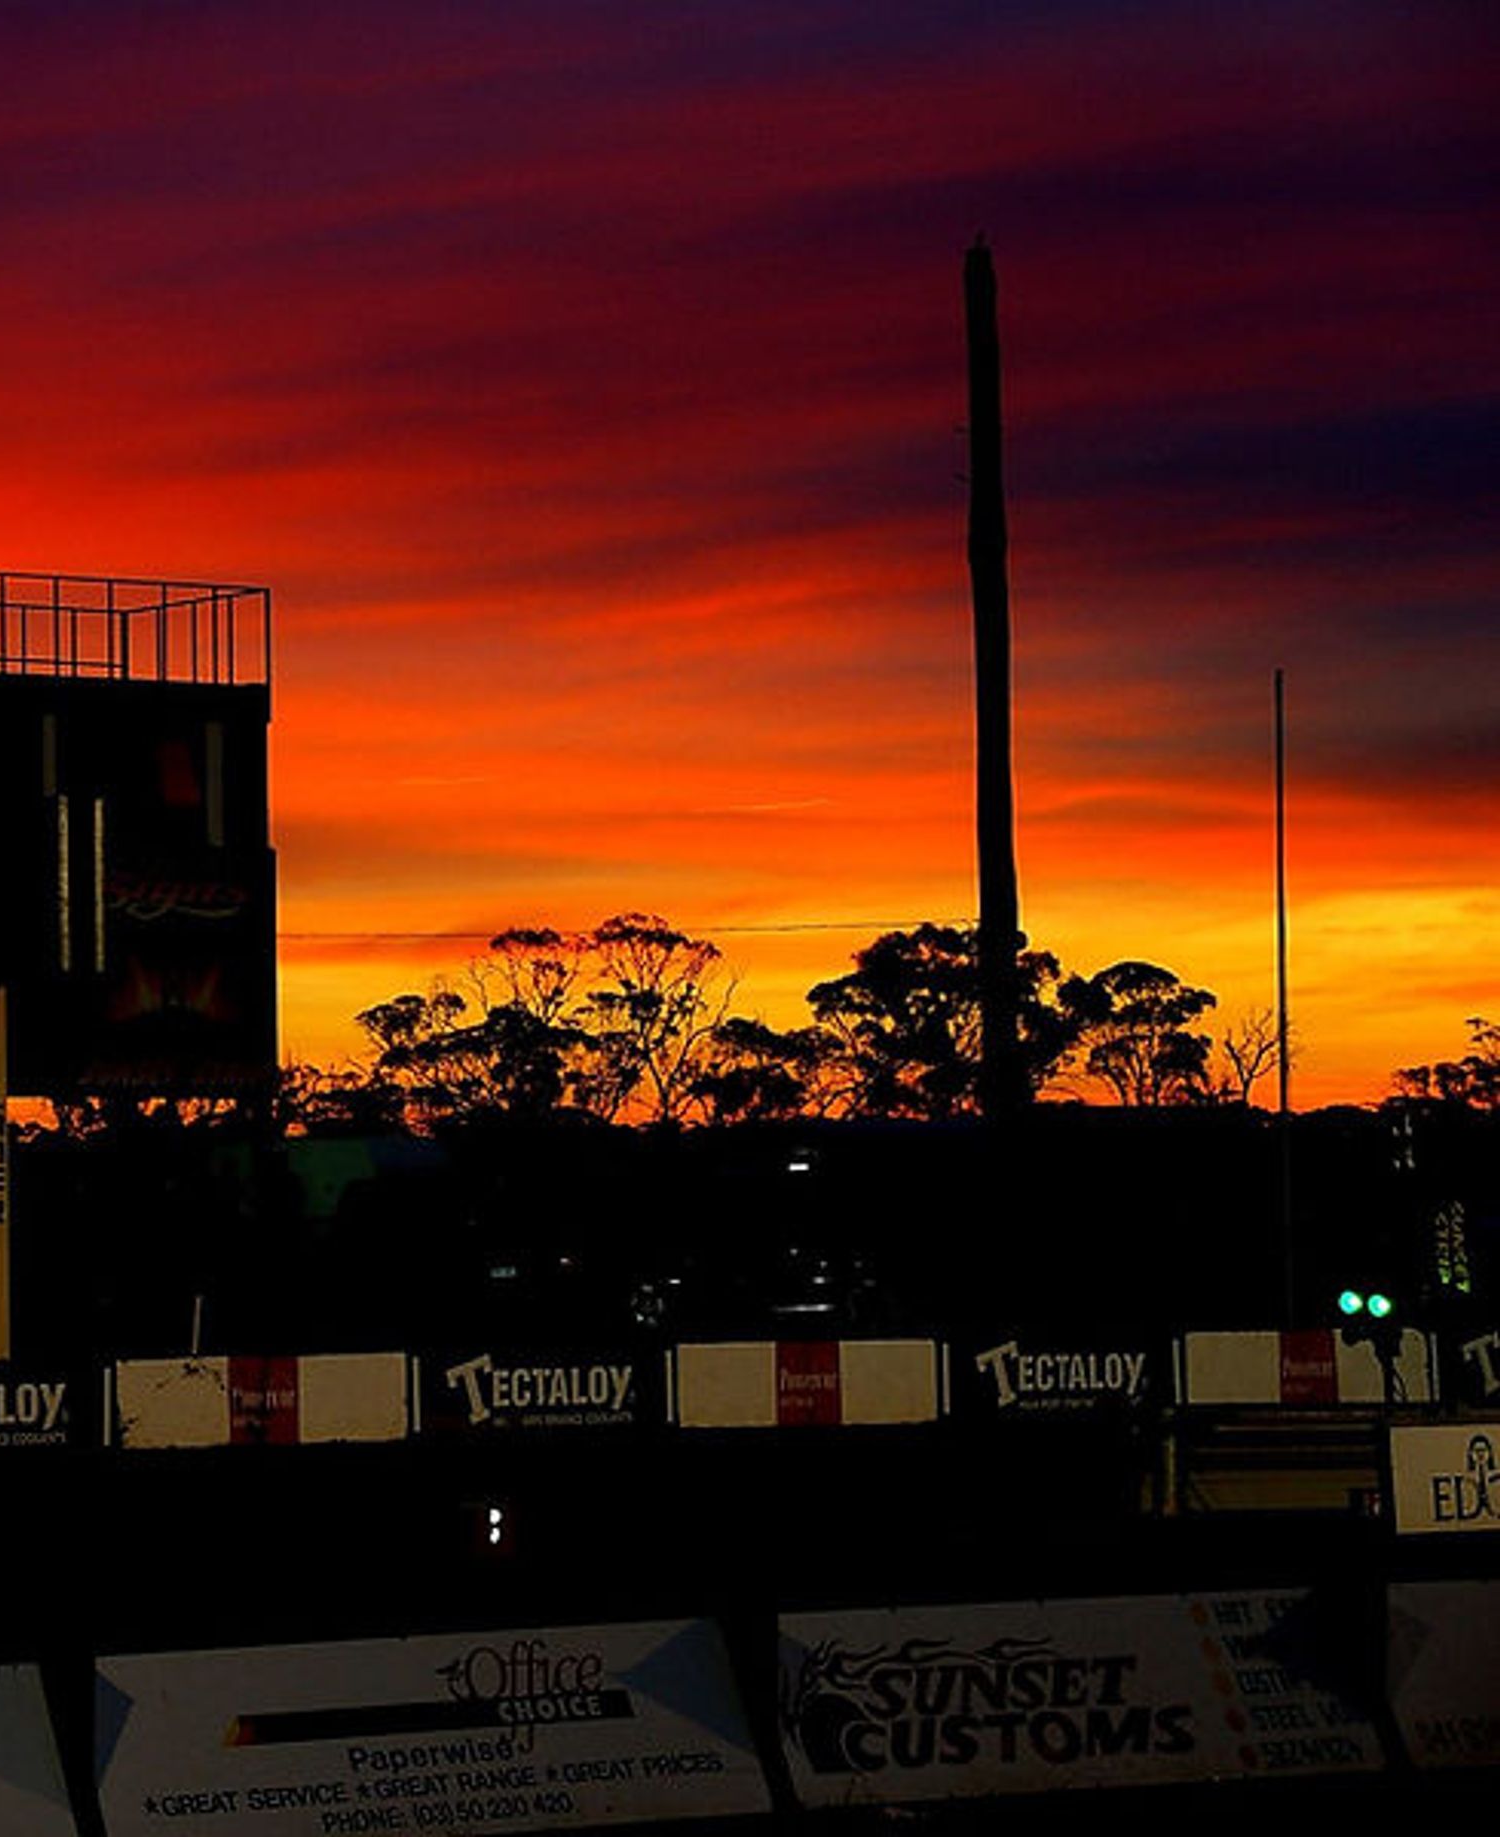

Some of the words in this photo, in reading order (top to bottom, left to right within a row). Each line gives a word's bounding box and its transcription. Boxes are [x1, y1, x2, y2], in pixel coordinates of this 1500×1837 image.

[446, 1353, 632, 1425] TECTALOY
[975, 1340, 1146, 1407] TECTALOY
[462, 1639, 604, 1753] Office
[501, 1695, 602, 1723] CHOICE
[868, 1654, 1138, 1720] SUNSET
[349, 1739, 511, 1775] Paperwise
[843, 1704, 1197, 1772] CUSTOMS
[247, 1782, 348, 1811] SERVICE
[457, 1766, 536, 1792] RANGE
